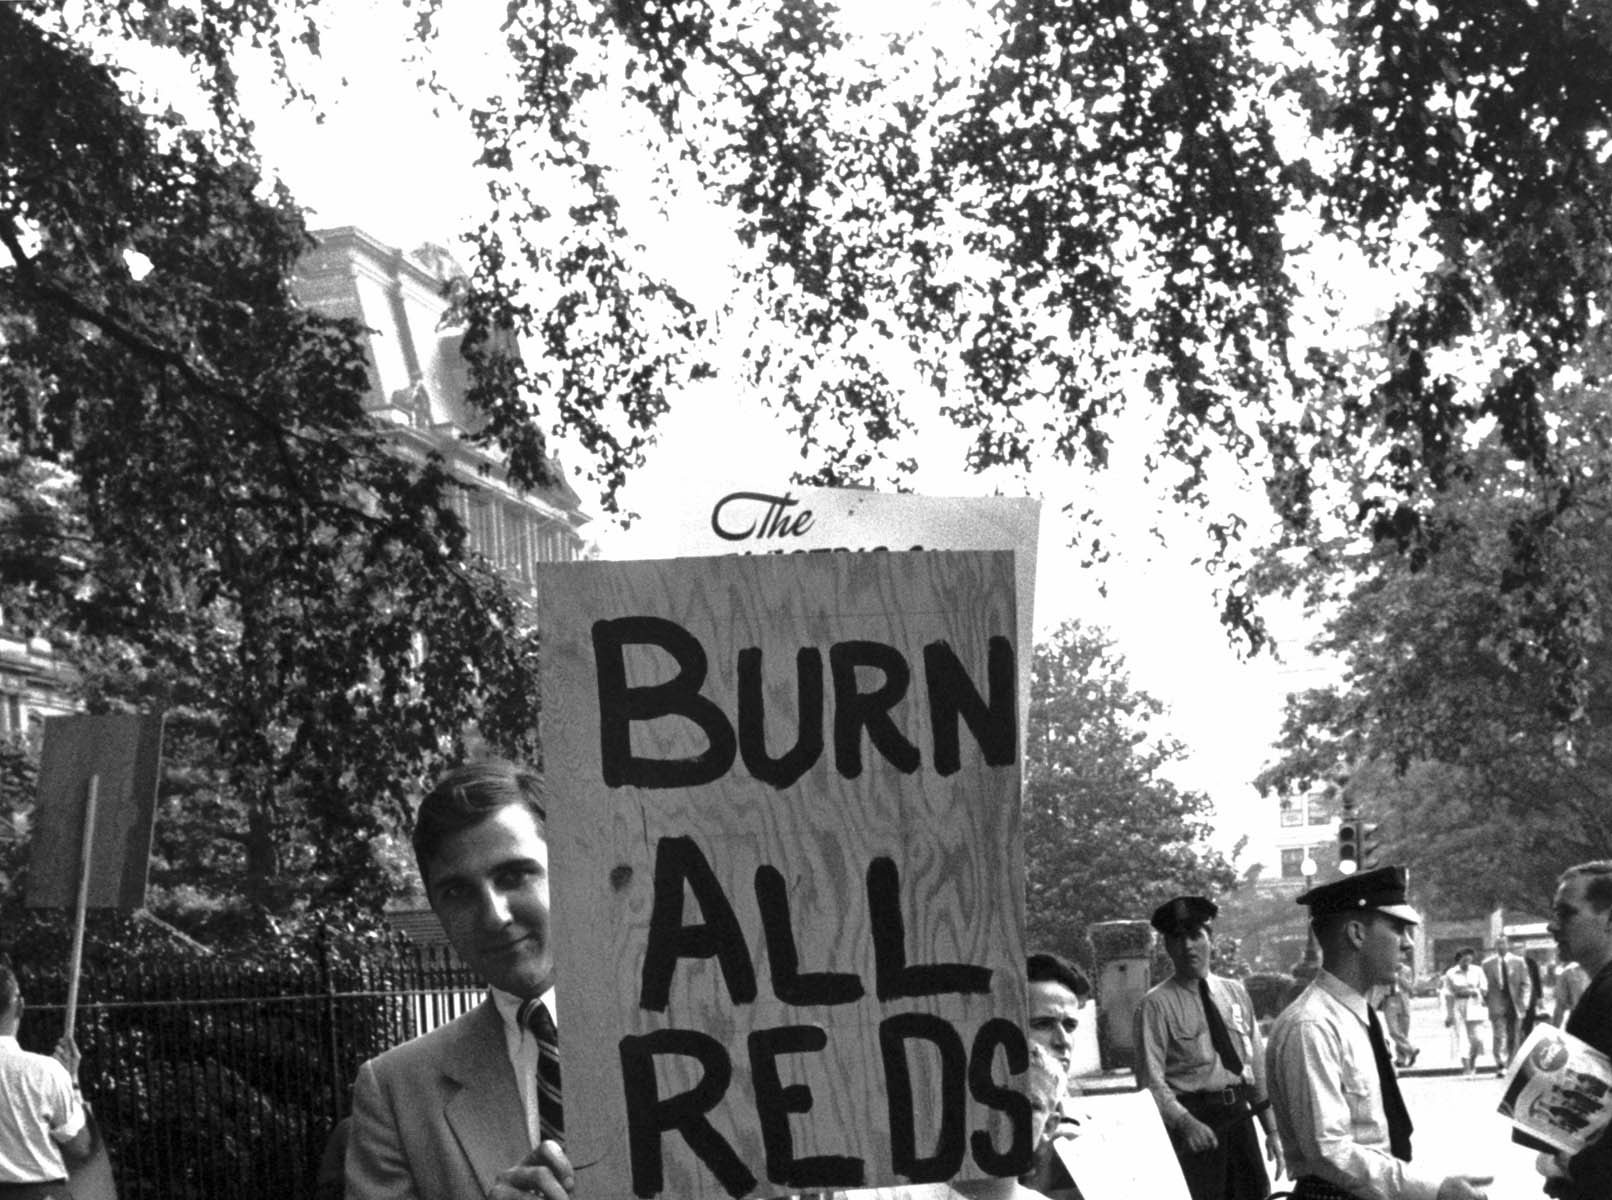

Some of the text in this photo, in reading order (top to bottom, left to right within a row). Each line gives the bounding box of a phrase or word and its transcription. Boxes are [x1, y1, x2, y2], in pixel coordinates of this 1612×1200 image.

[711, 490, 815, 541] The
[592, 616, 1017, 790] BURN
[640, 835, 993, 1012] ALL
[619, 1012, 1034, 1200] REDS
